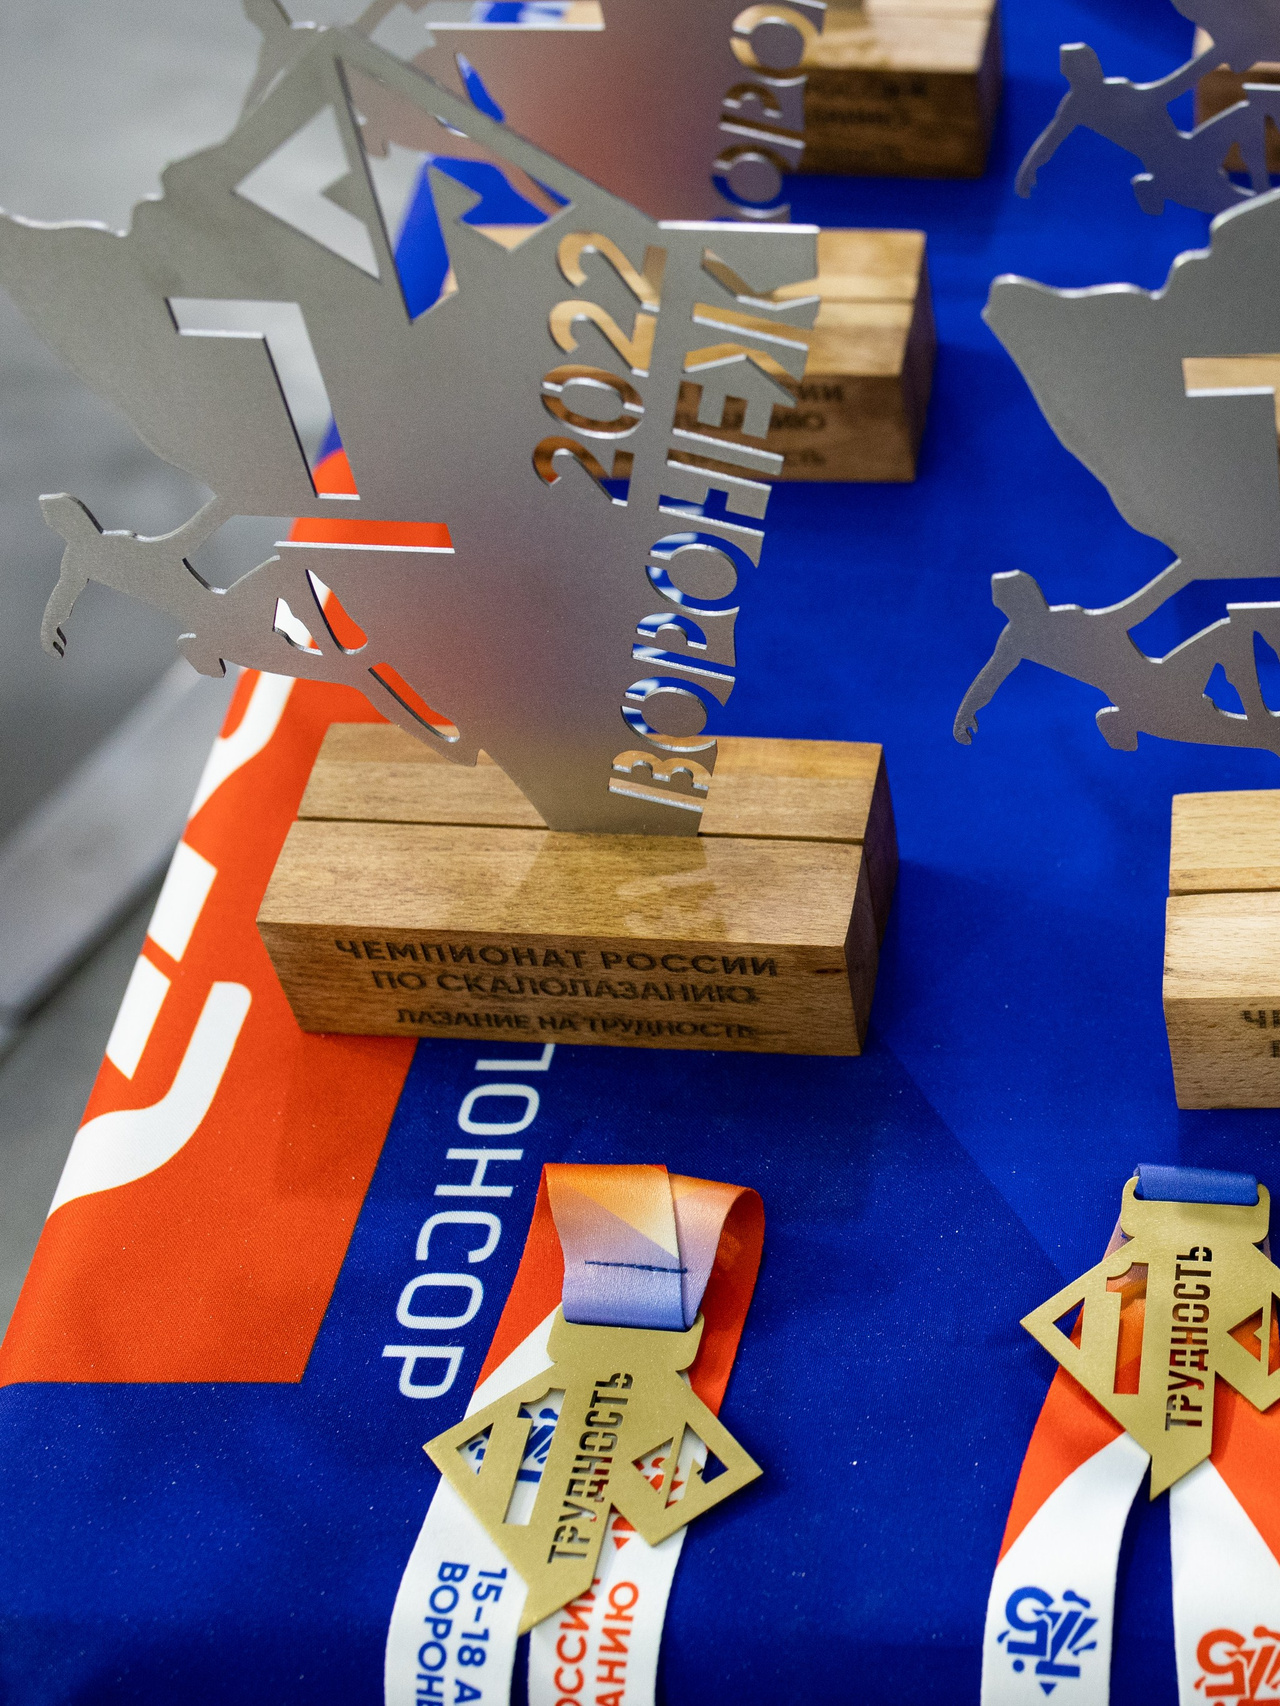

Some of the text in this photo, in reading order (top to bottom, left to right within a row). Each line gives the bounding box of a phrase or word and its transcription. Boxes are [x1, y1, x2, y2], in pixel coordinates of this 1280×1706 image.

[532, 231, 668, 507] 2022
[608, 246, 820, 812] ВОРОНЕЖ
[334, 938, 779, 977] ЧЕМПИОНАТ РОССИИ
[371, 969, 759, 1004] ПО СКАЛОЛАЗАНИЮ
[397, 1008, 757, 1039] ЛАЗАНИЕ НА ТРУДНОСТЬ
[1105, 1261, 1150, 1396] 1
[1164, 1245, 1213, 1432] ТРУДНОСТЬ
[502, 1386, 567, 1527] 1
[545, 1371, 634, 1565] ТРУДНОСТЬ
